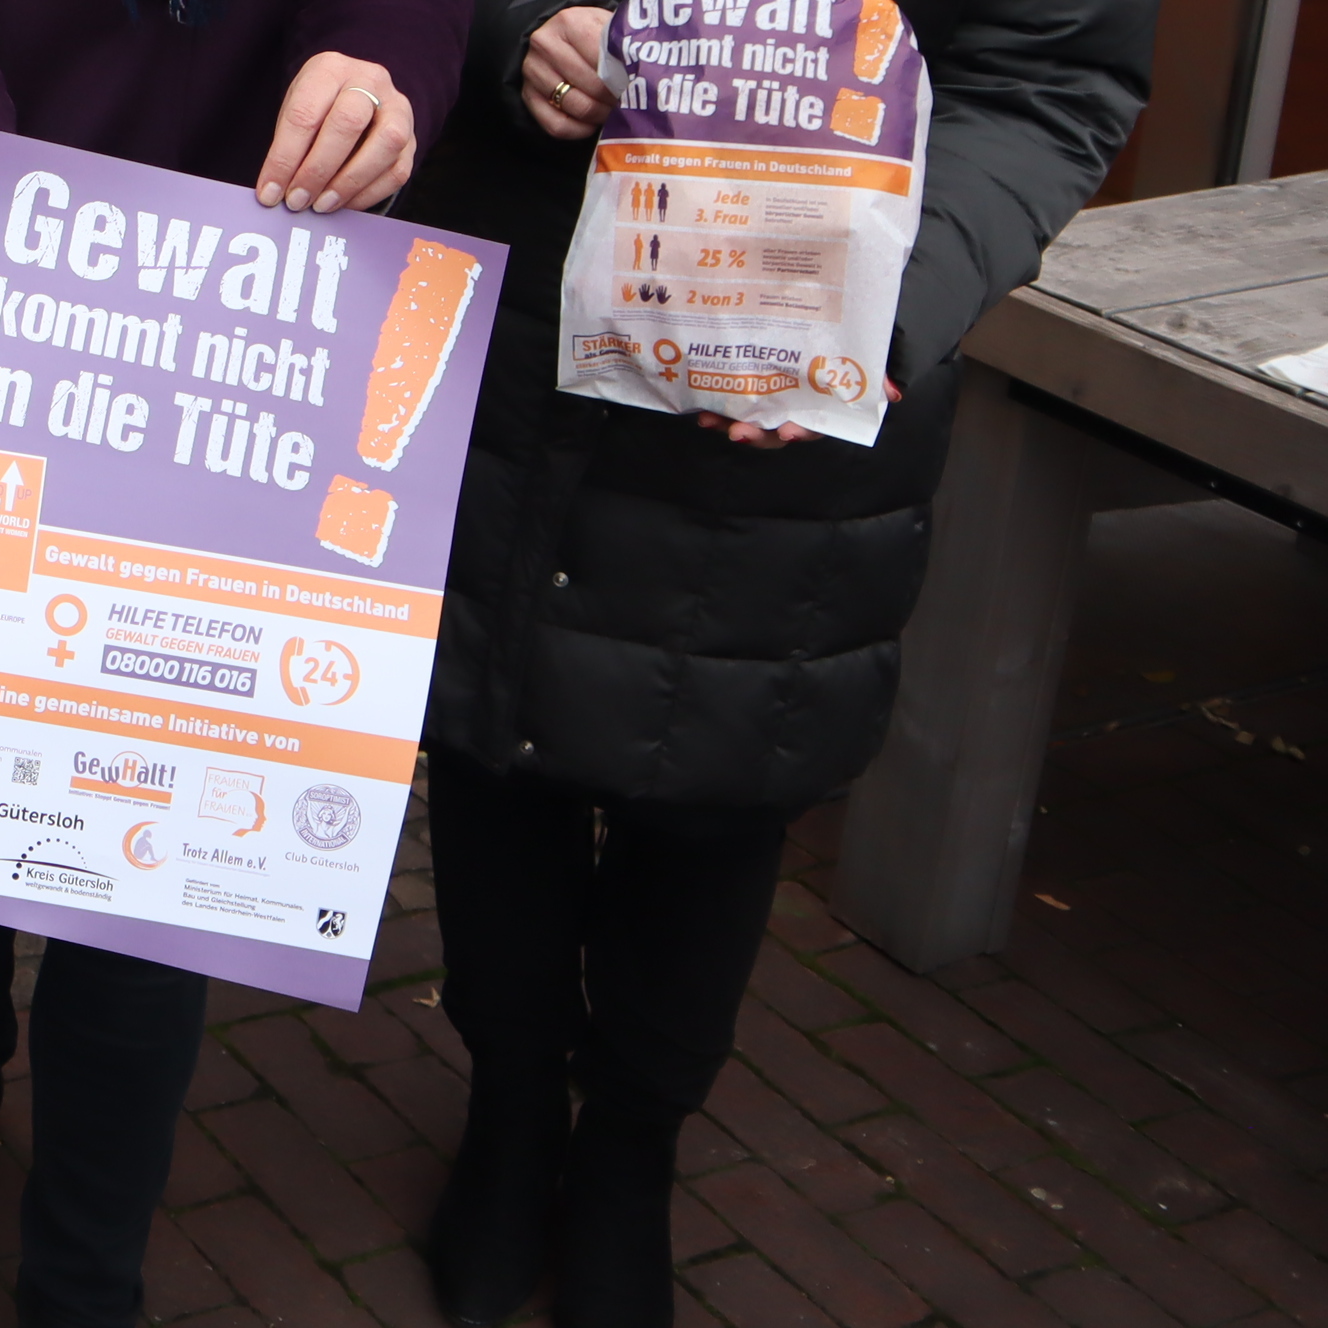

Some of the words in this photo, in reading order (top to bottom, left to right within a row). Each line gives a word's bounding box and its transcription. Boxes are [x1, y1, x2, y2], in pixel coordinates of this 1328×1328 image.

[621, 35, 733, 68] kommt
[742, 39, 829, 81] nicht
[618, 77, 647, 111] in
[656, 73, 718, 117] die
[732, 77, 825, 131] Tüte
[624, 152, 661, 164] Gewalt
[662, 155, 702, 168] gegen
[703, 156, 751, 170] Frauen
[753, 159, 766, 171] in
[769, 160, 852, 177] Deutschland
[5, 172, 346, 330] Gewalt
[192, 327, 329, 405] nicht
[687, 343, 732, 360] HILFE
[733, 343, 801, 363] TELEFON
[690, 374, 744, 391] 08000
[745, 375, 768, 392] 116
[825, 370, 853, 391] 24
[47, 371, 148, 451] die
[174, 392, 313, 489] Tüte
[13, 486, 32, 501] UP
[4, 527, 28, 537] WOMEN
[44, 545, 115, 572] Gewalt
[119, 560, 181, 583] gegen
[185, 567, 257, 595] Frauen
[260, 578, 282, 601] in
[285, 584, 409, 620] Deutschland
[107, 603, 168, 629] HILFE
[171, 612, 262, 645] TELEFON
[105, 627, 159, 646] GEWALT
[159, 636, 204, 654] GEGEN
[206, 643, 260, 663] FRAUEN
[105, 650, 179, 679] 08000
[181, 662, 212, 685] 116
[213, 668, 251, 691] 016
[302, 656, 338, 687] 24
[34, 695, 163, 728] gemeinsame
[168, 713, 258, 744] Initiative
[263, 733, 300, 752] von
[182, 842, 208, 860] Trotz
[210, 847, 243, 866] Allem
[246, 856, 266, 871] e.V.
[284, 851, 308, 863] Club
[309, 855, 359, 872] Gütersloh
[25, 866, 54, 881] Kreis
[58, 872, 113, 891] Gütersloh
